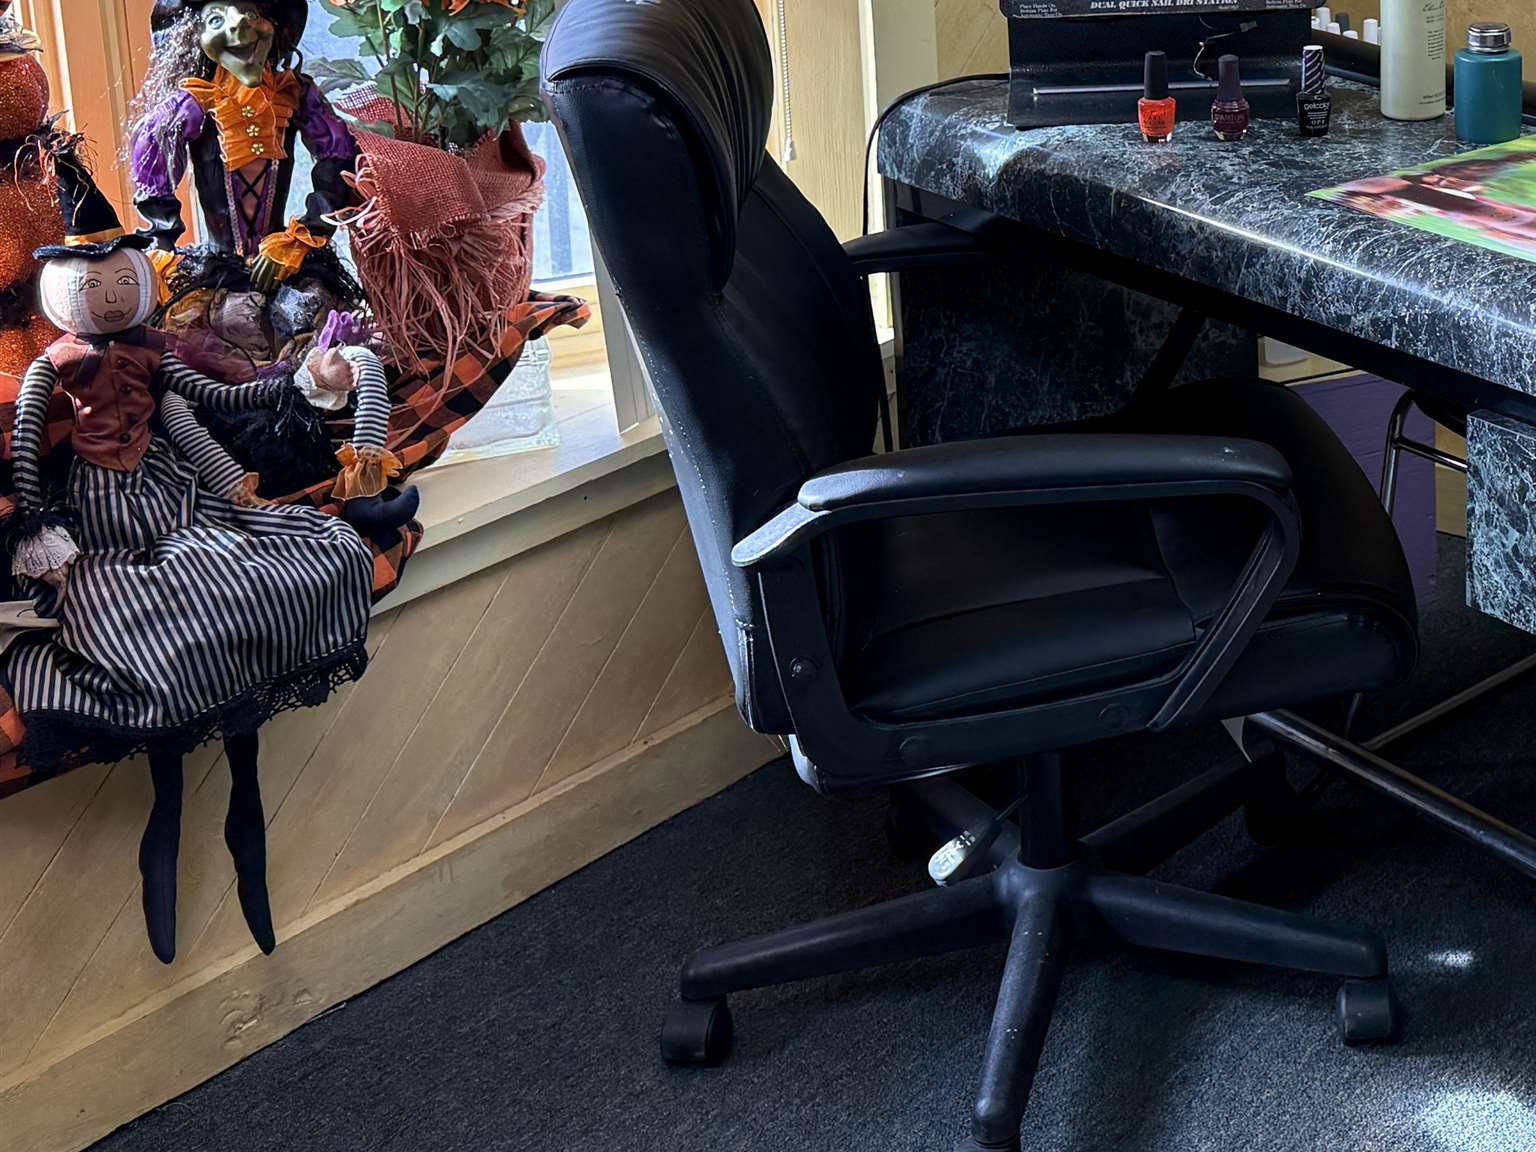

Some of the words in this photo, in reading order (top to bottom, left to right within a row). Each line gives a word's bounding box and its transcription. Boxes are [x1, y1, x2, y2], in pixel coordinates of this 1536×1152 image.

[1090, 0, 1116, 9] DUAL
[1119, 0, 1149, 10] QUICK
[1151, 0, 1173, 7] NAIL
